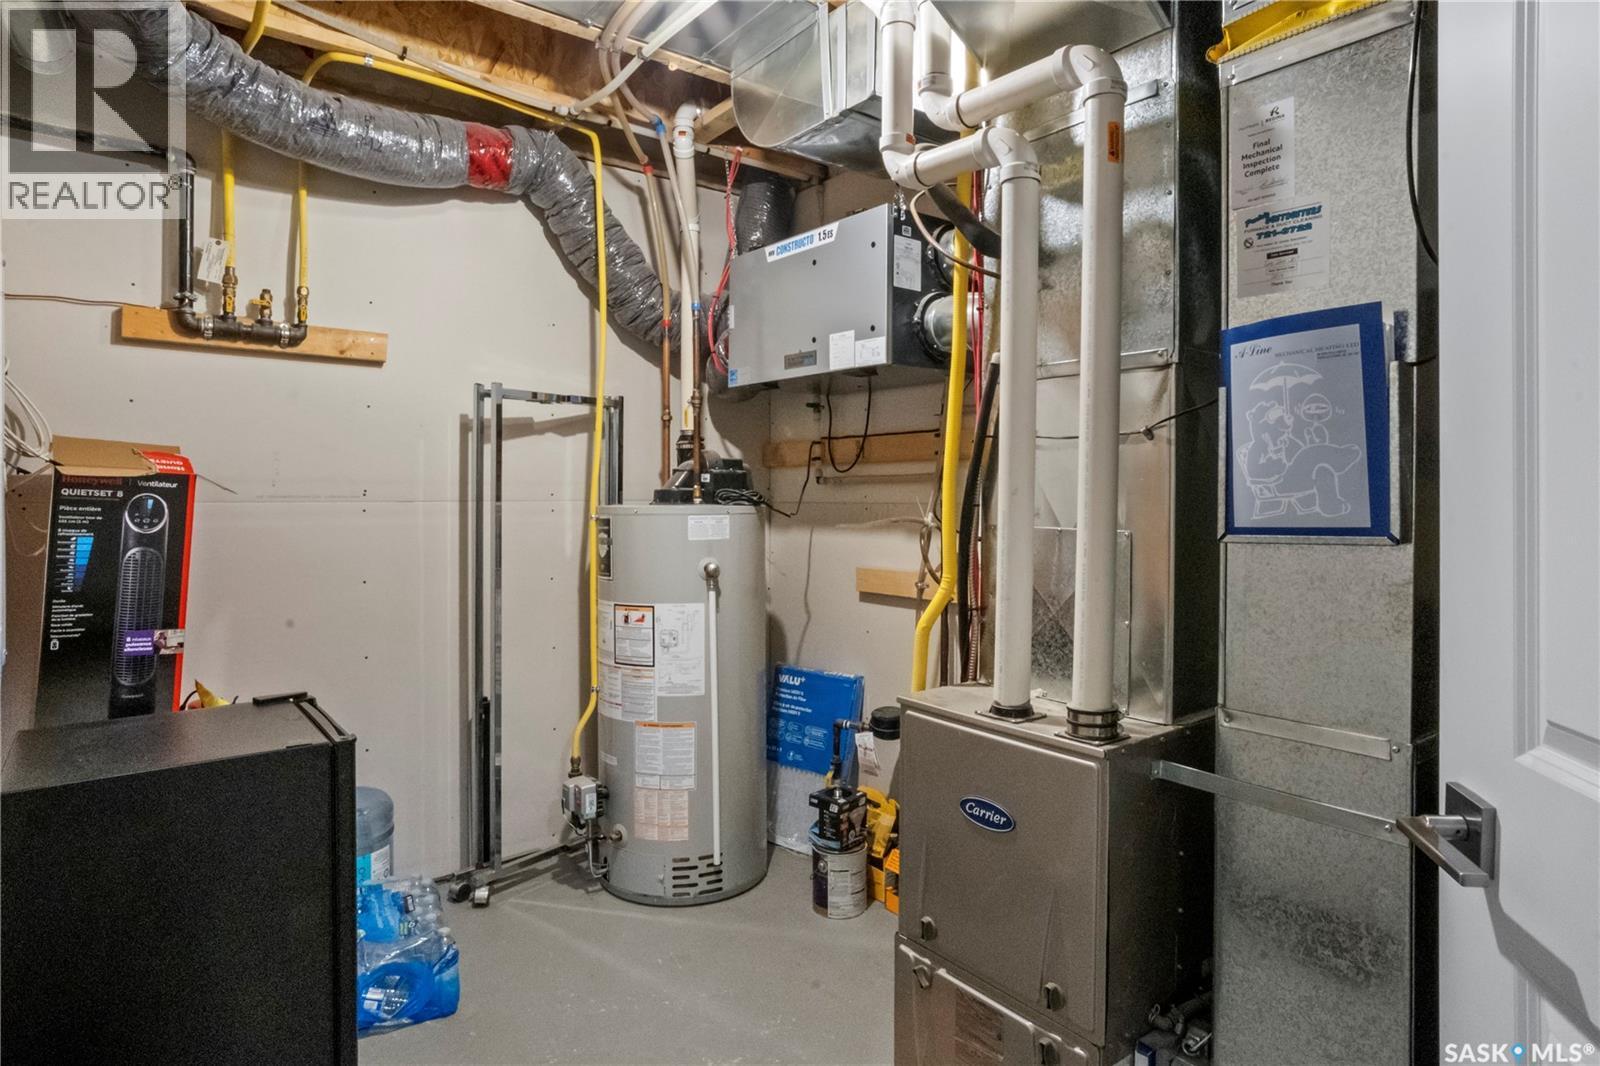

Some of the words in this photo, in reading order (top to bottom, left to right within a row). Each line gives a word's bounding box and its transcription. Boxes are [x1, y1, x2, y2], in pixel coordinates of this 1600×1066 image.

[1252, 138, 1271, 150] Final
[1241, 144, 1283, 161] Mechanical
[1243, 154, 1281, 170] Inspection
[1244, 164, 1280, 178] Complete
[776, 234, 815, 256] CONSTRUCTO
[137, 480, 178, 488] Ventilateur
[61, 488, 113, 497] QUIETSET
[116, 489, 123, 498] 8
[965, 802, 1007, 825] Carrier
